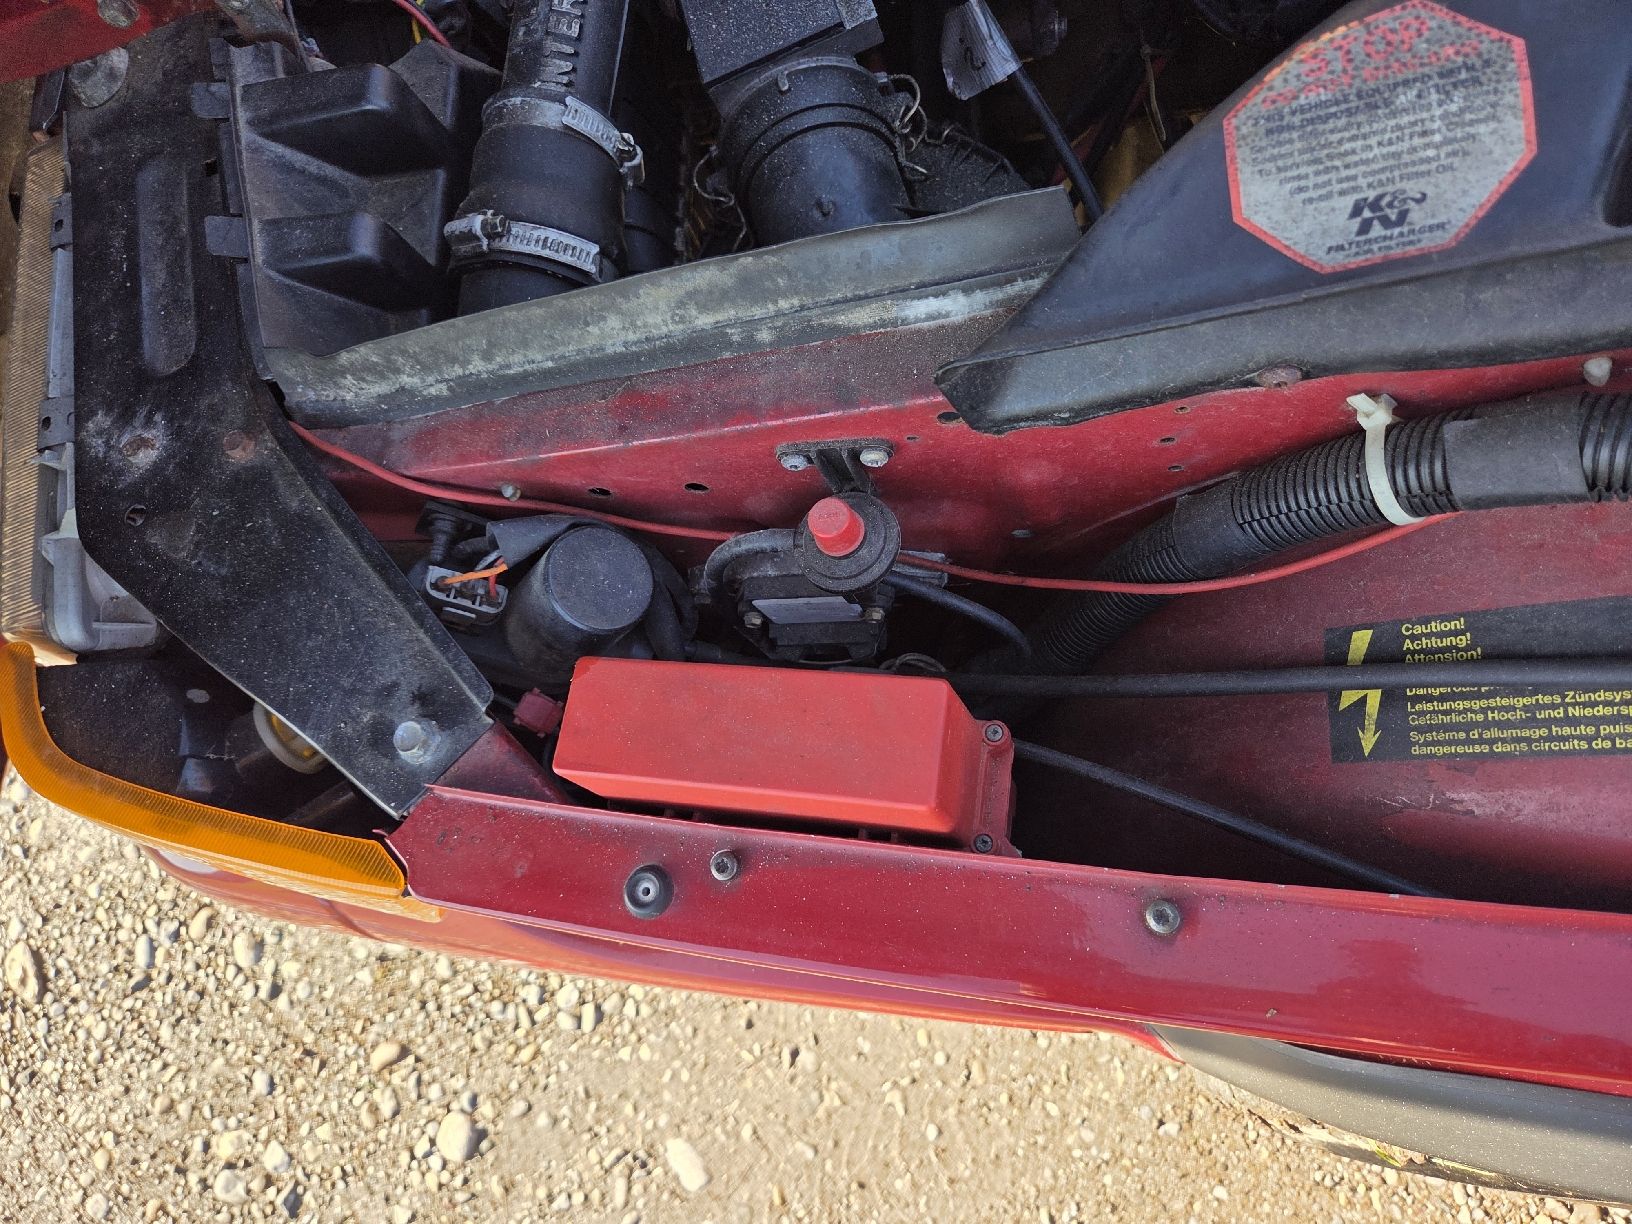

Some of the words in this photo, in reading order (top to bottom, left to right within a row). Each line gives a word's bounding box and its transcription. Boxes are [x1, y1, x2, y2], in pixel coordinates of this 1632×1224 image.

[1297, 15, 1431, 79] STOP
[1375, 133, 1406, 149] K&N
[1365, 175, 1396, 191] K&N
[1398, 166, 1432, 183] Filter
[1401, 617, 1465, 636] Caution!
[1402, 632, 1471, 651] Achtung!
[1407, 694, 1562, 712] Leistungsgesteigertes
[1564, 689, 1632, 703] Zündsys
[1408, 711, 1485, 725] Gefährliche
[1487, 709, 1532, 721] Hoch-
[1535, 706, 1565, 719] und
[1469, 727, 1549, 739] d'allumage
[1551, 724, 1596, 736] haute
[1411, 744, 1490, 756] dangereuse
[1492, 741, 1529, 752] dans
[1531, 738, 1589, 751] circuits
[1591, 737, 1613, 749] de
